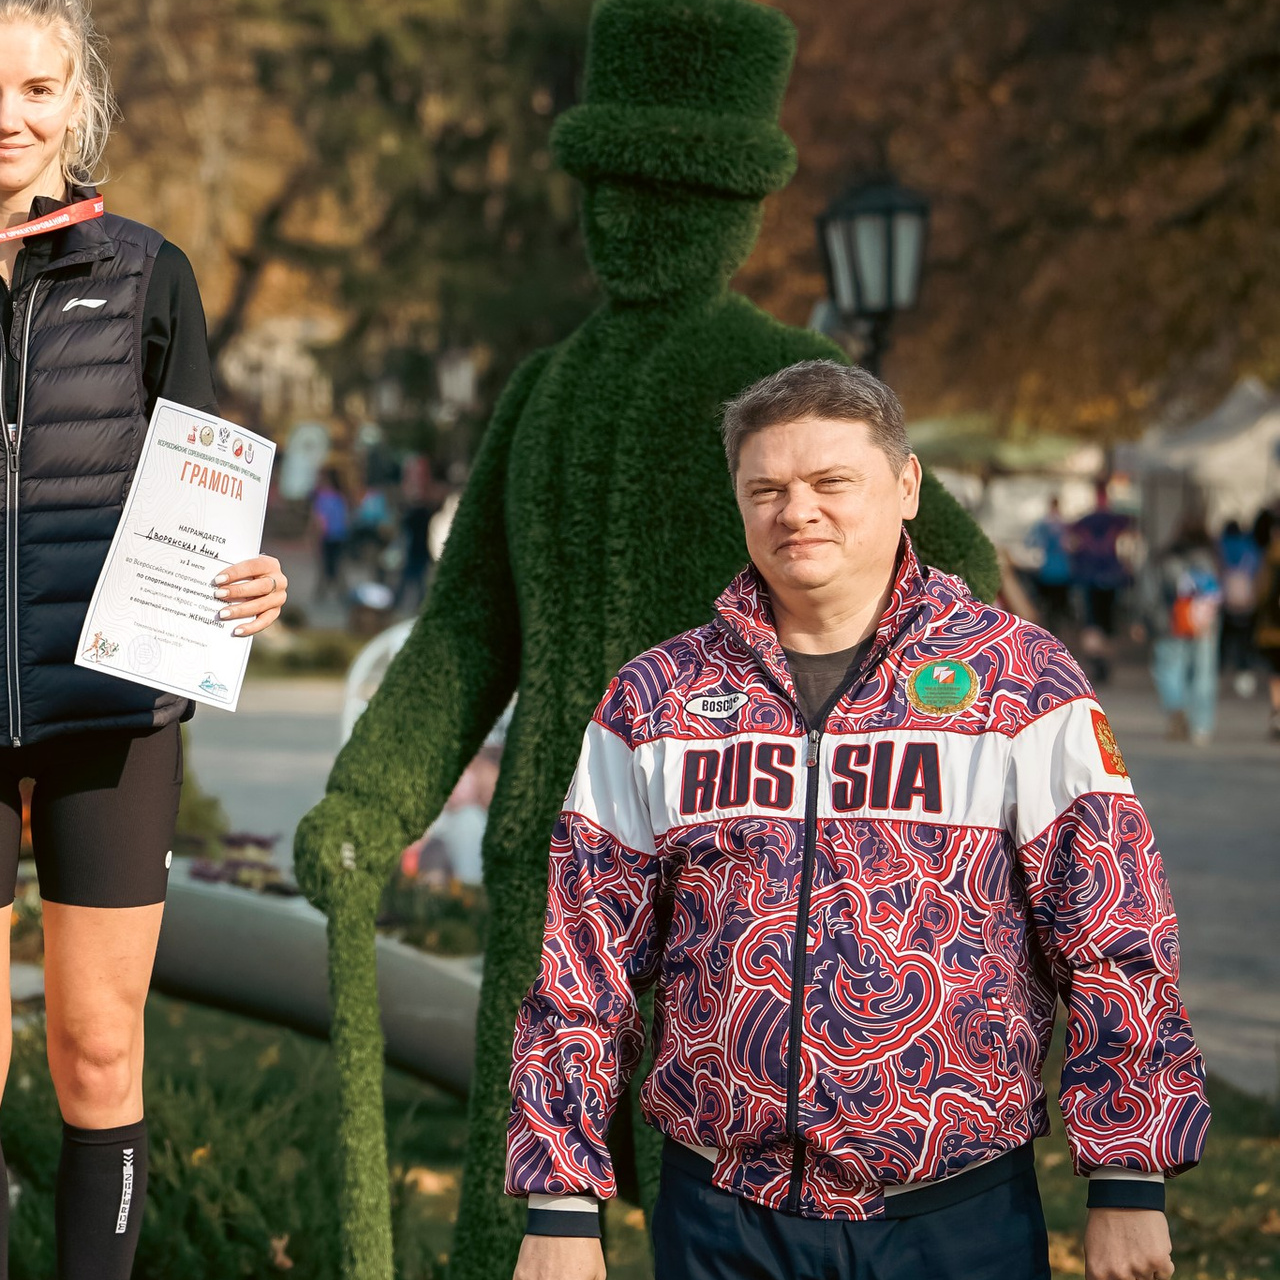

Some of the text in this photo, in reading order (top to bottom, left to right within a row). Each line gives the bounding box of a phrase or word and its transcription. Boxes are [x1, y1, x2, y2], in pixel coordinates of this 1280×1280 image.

[180, 460, 243, 501] ГРАМОТА
[178, 525, 227, 544] НАГРАЖДАЕТСЯ
[188, 613, 225, 629] ЖЕНЩИНЫ
